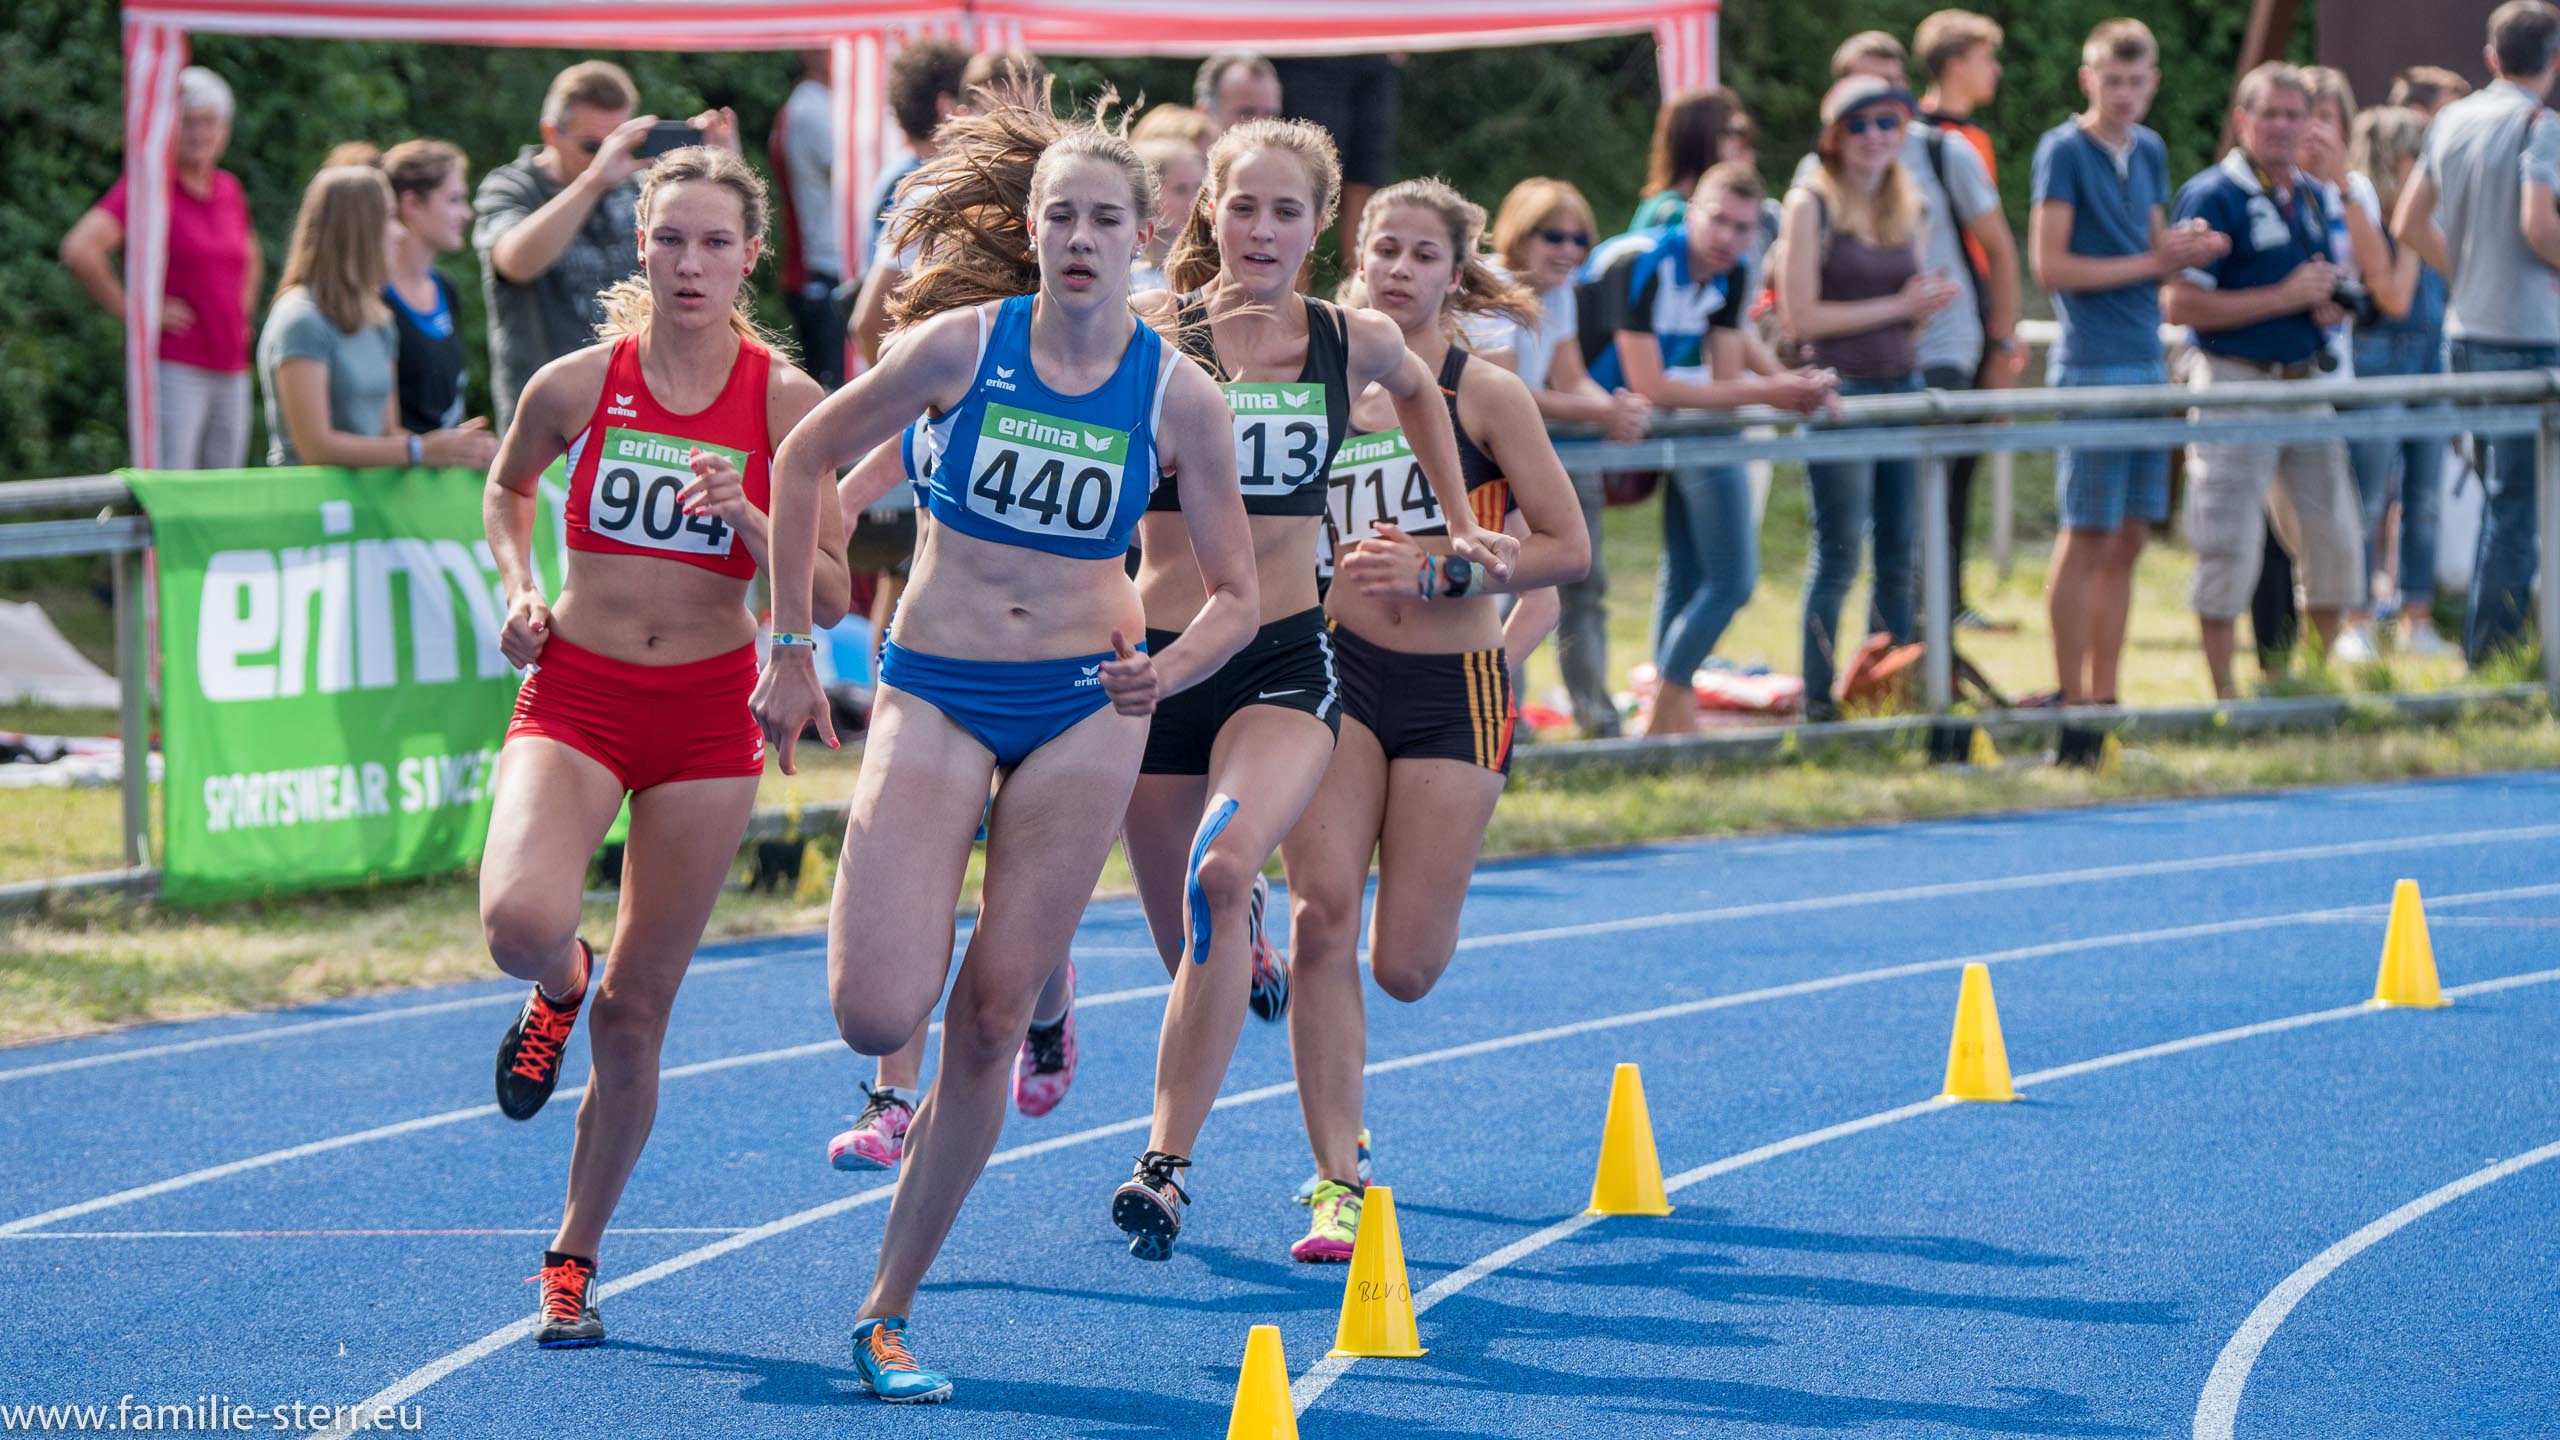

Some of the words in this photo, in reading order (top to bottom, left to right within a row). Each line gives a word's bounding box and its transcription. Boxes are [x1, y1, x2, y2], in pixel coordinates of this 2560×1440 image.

[986, 378, 1017, 392] erima
[1225, 390, 1279, 409] ima
[607, 405, 637, 418] erima
[998, 416, 1079, 449] erima
[1240, 421, 1319, 486] 13
[1333, 440, 1395, 465] erima
[598, 467, 729, 547] 904
[973, 449, 1113, 532] 440
[1329, 461, 1440, 535] 714
[203, 761, 391, 834] SPORTSWEAR
